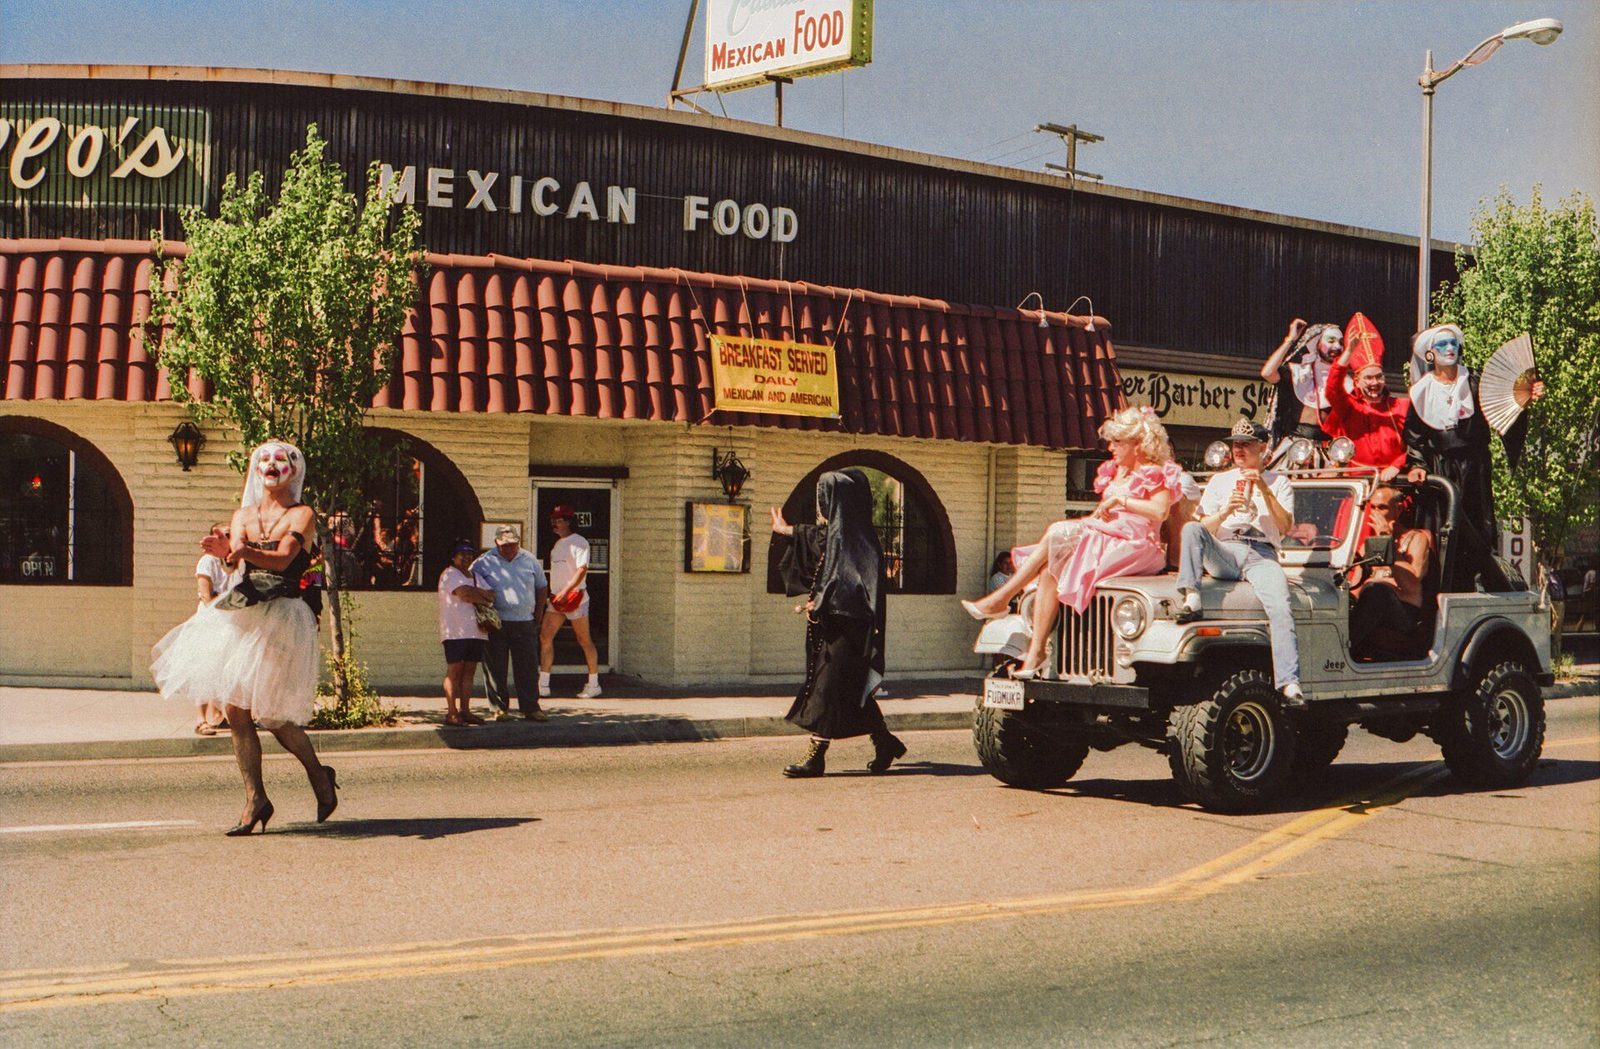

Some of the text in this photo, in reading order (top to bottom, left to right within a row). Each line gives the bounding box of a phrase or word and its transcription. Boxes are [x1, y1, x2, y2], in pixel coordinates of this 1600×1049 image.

[712, 38, 786, 71] MEXICAN
[793, 10, 844, 54] FOOD
[0, 117, 184, 189] eo's
[380, 163, 798, 242] MEXICAN FOOD
[720, 343, 828, 375] BREAKFAST SERVED
[723, 387, 832, 407] MEXICAN AND AMERICAN
[754, 374, 798, 386] DAILY
[1121, 375, 1146, 397] er
[1148, 373, 1236, 418] Barber
[1324, 659, 1346, 670] Jeep
